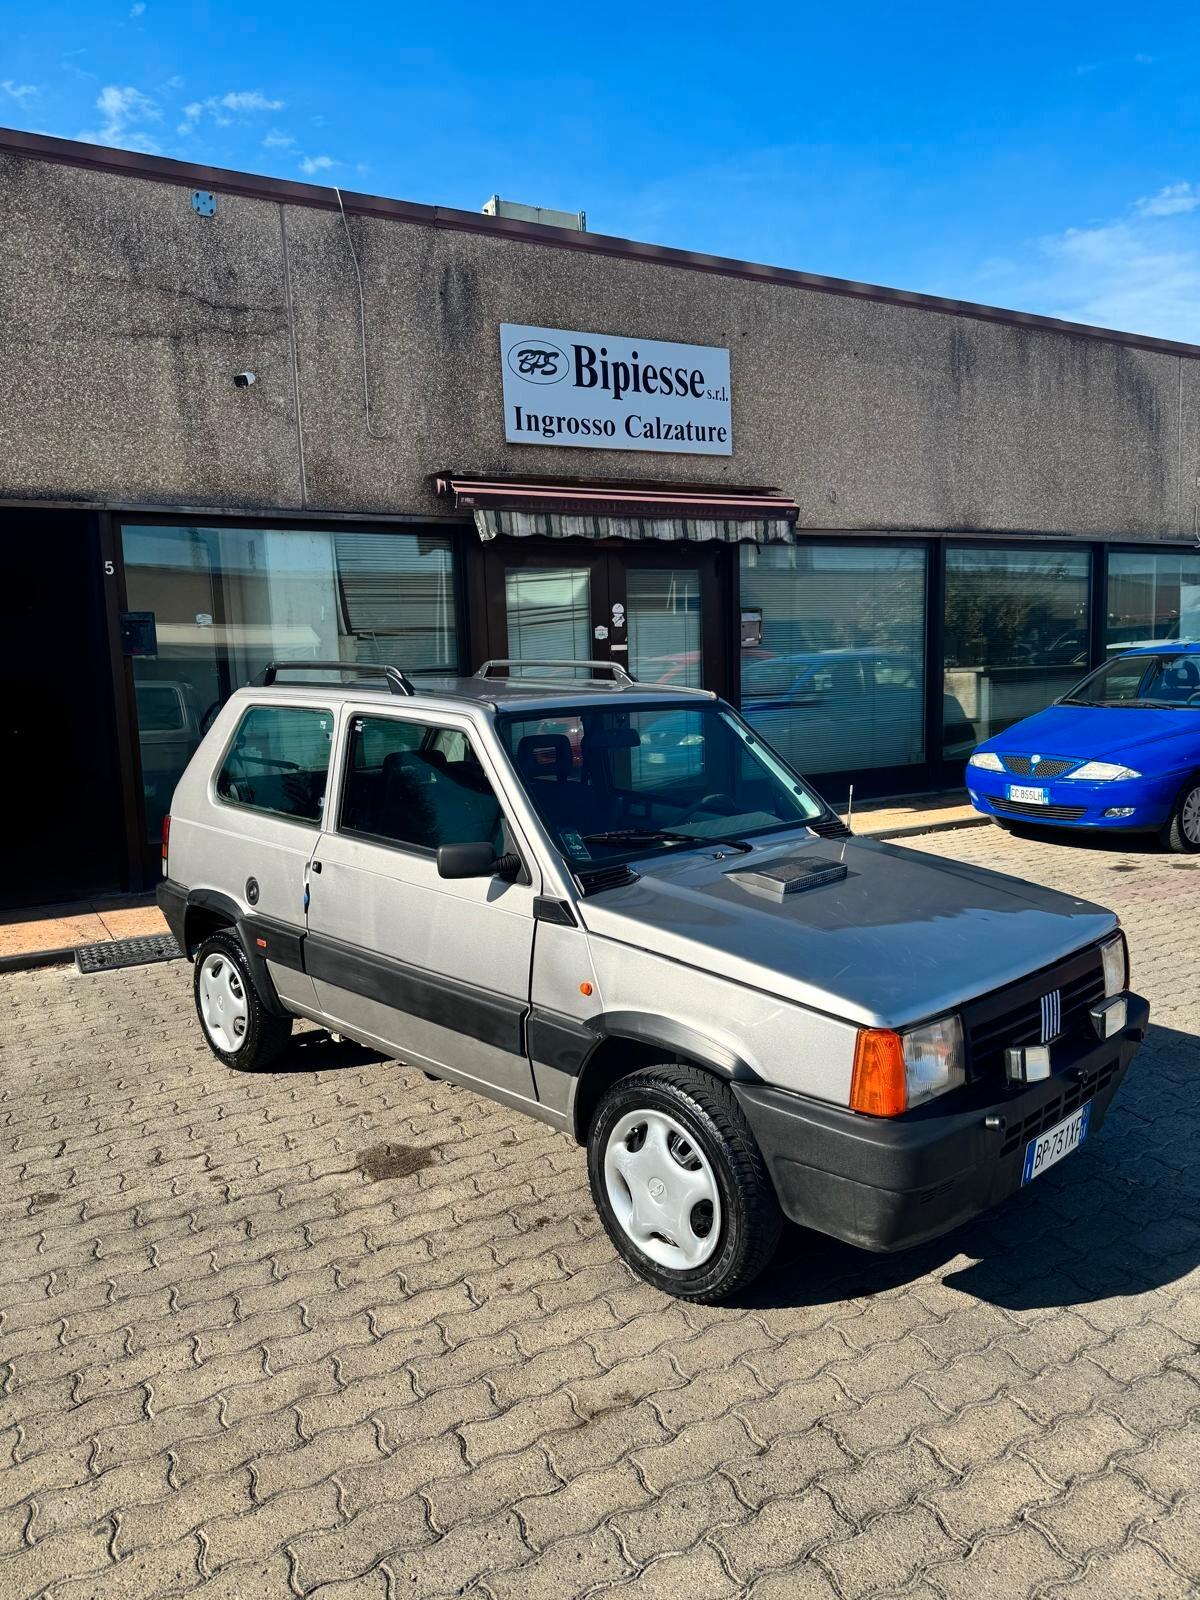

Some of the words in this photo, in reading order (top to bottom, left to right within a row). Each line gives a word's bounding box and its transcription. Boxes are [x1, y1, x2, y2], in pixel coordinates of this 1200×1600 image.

[571, 343, 705, 400] Bipiesse
[707, 386, 729, 402] s.r.l.
[513, 405, 616, 438] Ingrosso
[624, 414, 728, 443] Calzature
[104, 560, 115, 575] 5
